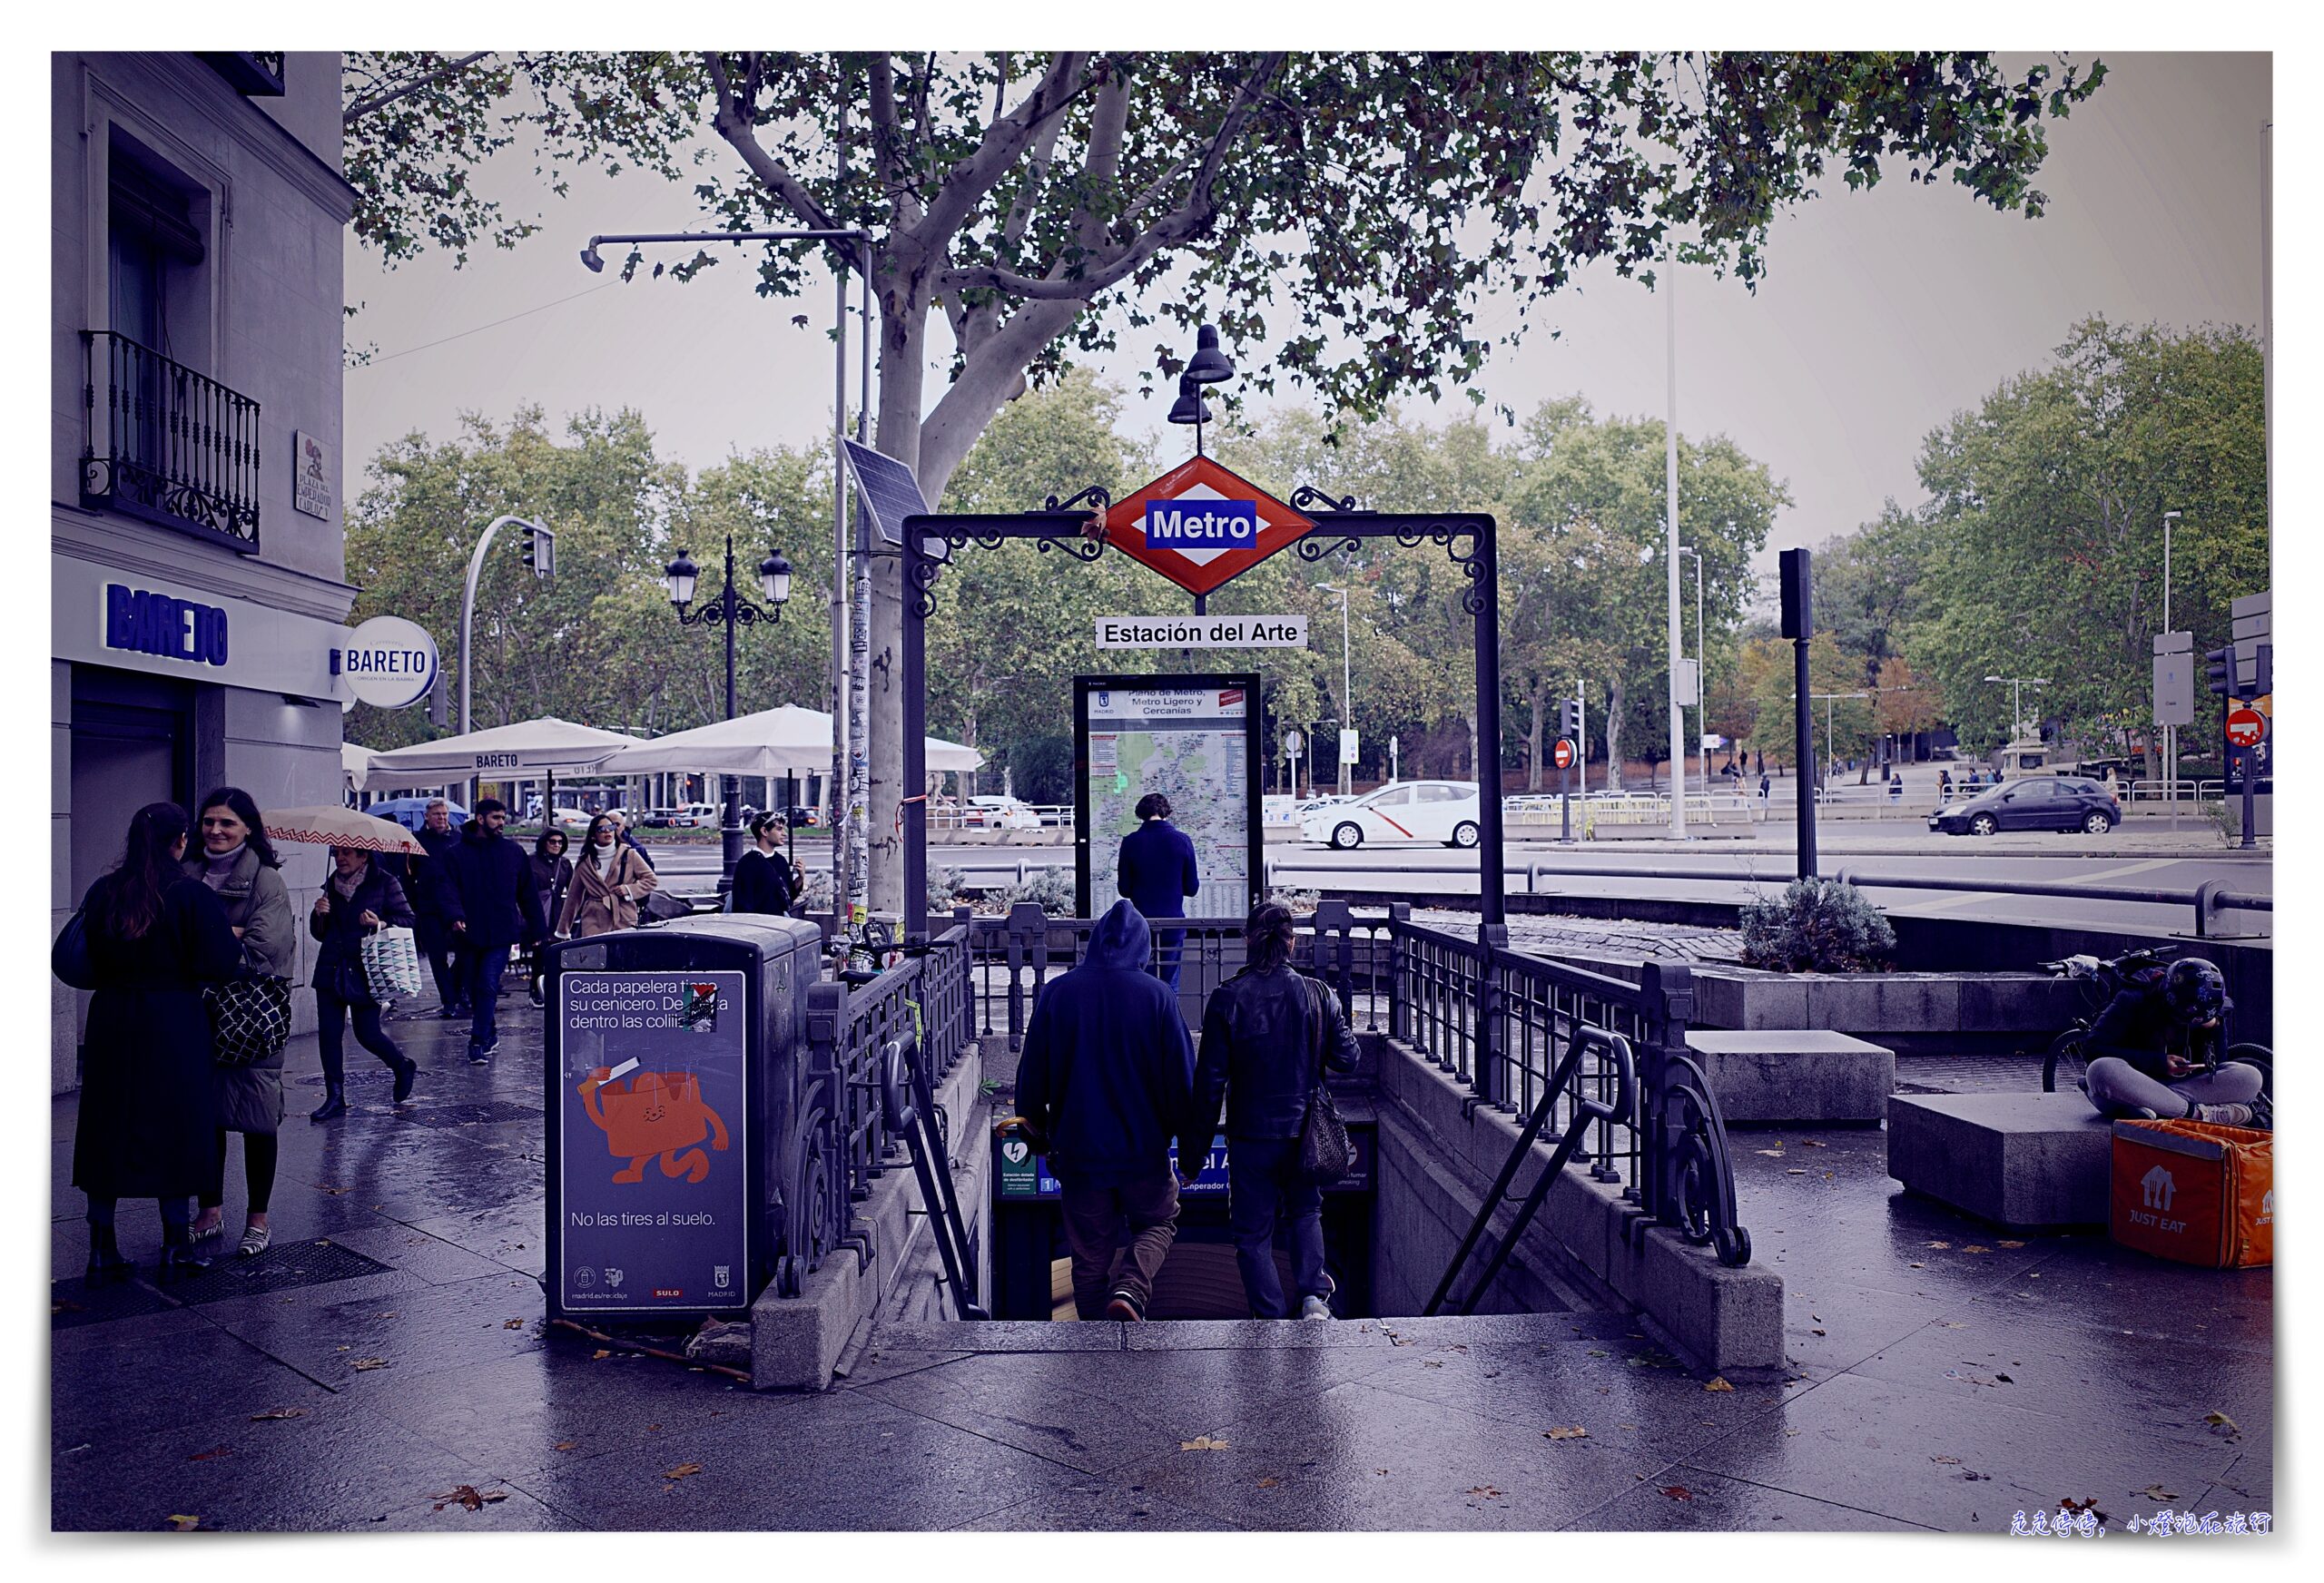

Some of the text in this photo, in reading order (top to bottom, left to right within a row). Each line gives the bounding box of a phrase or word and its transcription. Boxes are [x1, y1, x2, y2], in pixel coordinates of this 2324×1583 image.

[300, 473, 320, 490] PLAZA
[297, 484, 331, 507] EMPERADOR
[299, 497, 329, 517] CARLOS V
[1153, 510, 1251, 538] Metro
[107, 584, 228, 666] BARETO
[1104, 623, 1298, 643] Estación del Arte
[347, 649, 426, 674] BARETO
[1132, 698, 1203, 708] Metro Ligero y
[1142, 706, 1191, 714] Cercanías
[477, 754, 517, 768] BARETO
[569, 979, 609, 994] Cada
[613, 979, 677, 997] papelera
[569, 999, 588, 1011] su
[591, 997, 659, 1011] cenicero.
[569, 1014, 618, 1028] dentro
[622, 1014, 643, 1028] las
[1045, 1180, 1050, 1190] 1
[1182, 1182, 1226, 1191] mperador
[571, 1211, 716, 1226] No las tires al suelo.
[2129, 1209, 2187, 1234] JUST EAT
[2255, 1217, 2270, 1225] JUST
